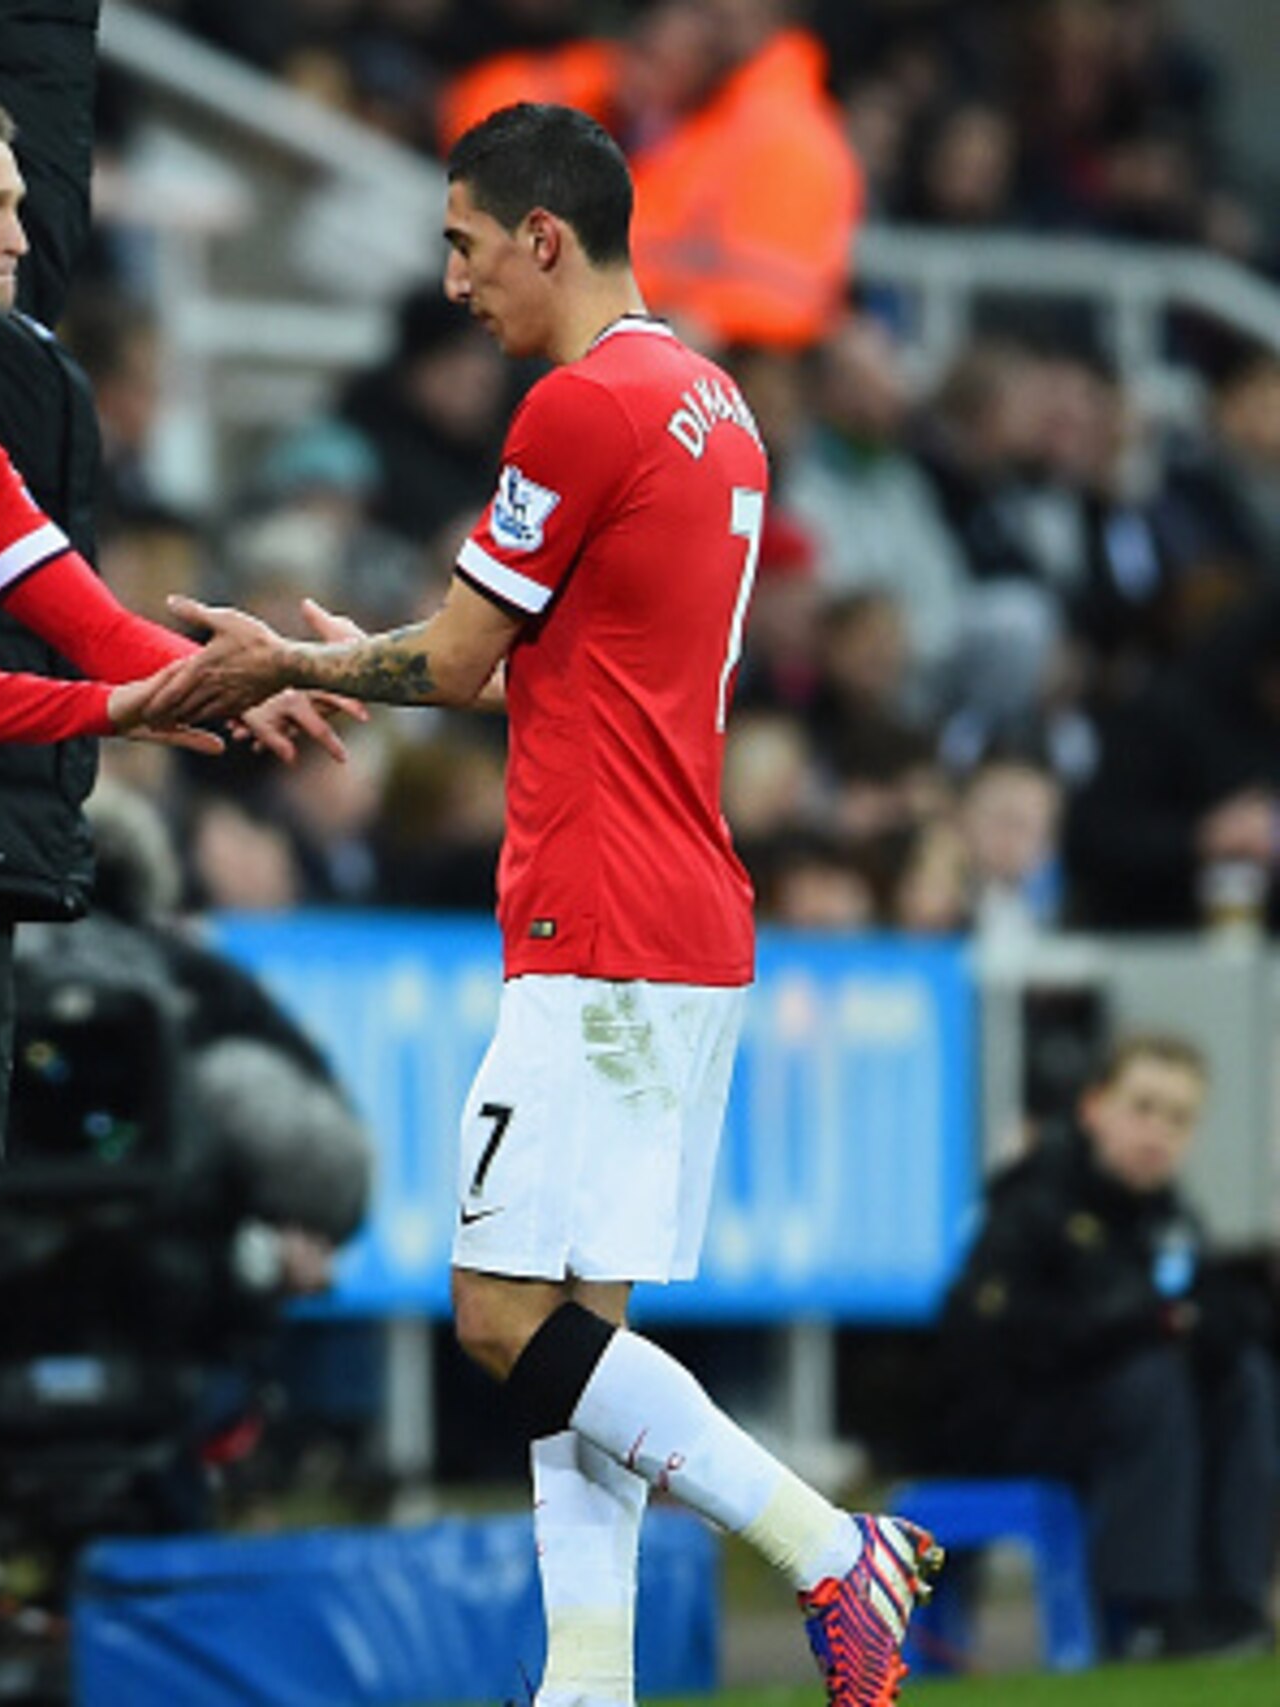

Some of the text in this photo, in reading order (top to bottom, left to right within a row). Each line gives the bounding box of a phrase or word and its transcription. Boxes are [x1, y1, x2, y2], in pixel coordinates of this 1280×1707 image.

[667, 390, 711, 459] DI
[716, 487, 764, 733] 7
[470, 1102, 513, 1198] 7
